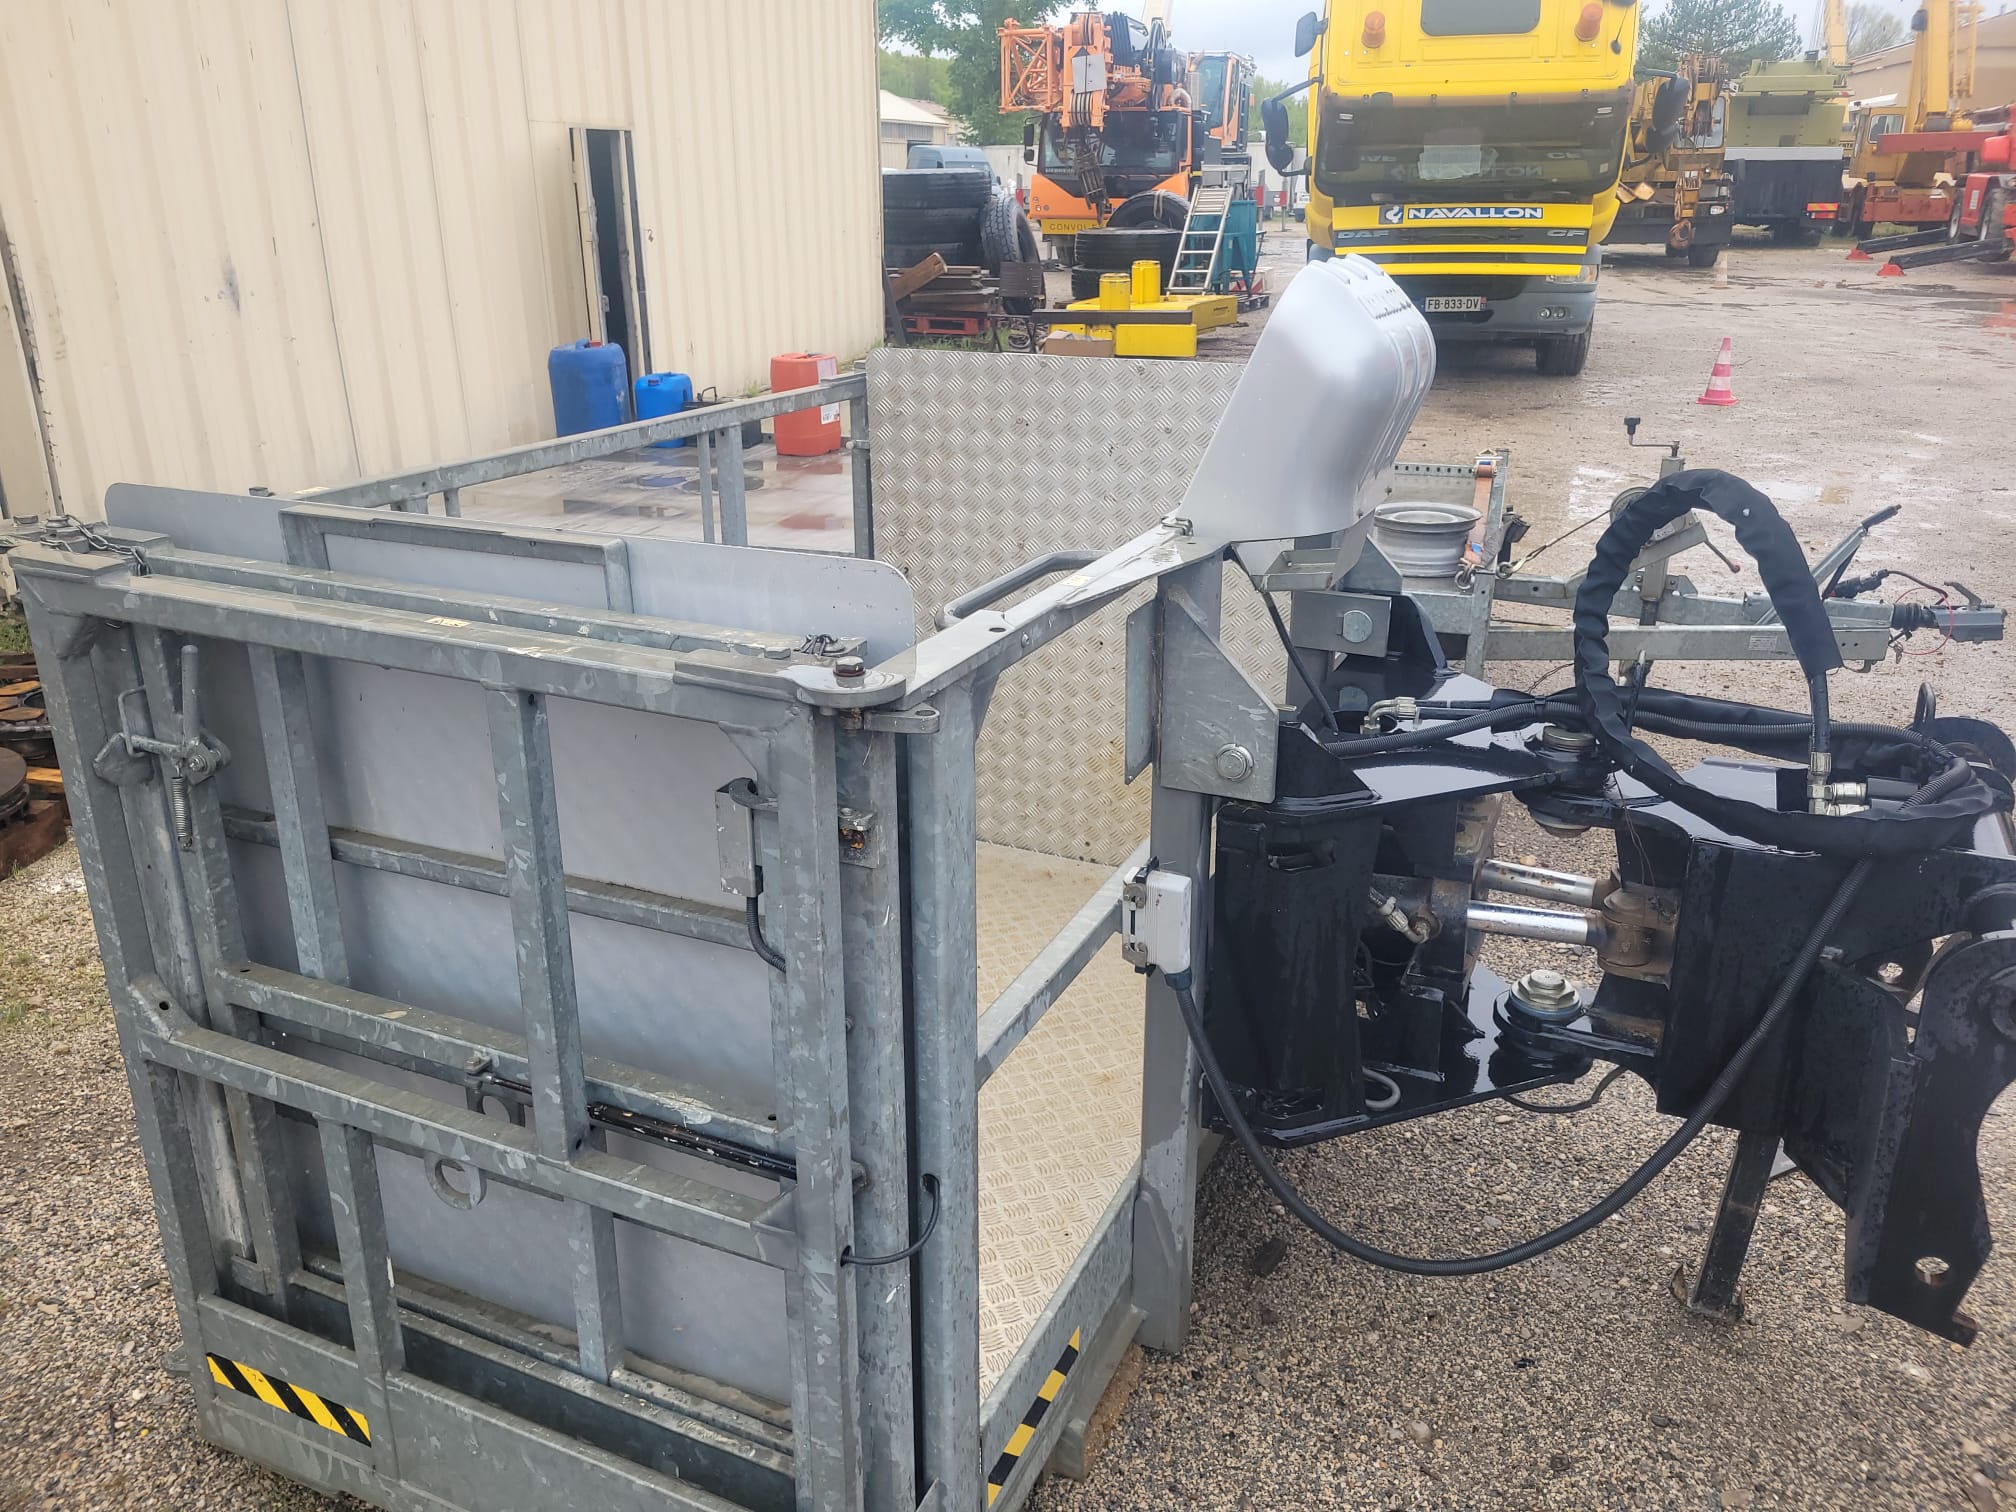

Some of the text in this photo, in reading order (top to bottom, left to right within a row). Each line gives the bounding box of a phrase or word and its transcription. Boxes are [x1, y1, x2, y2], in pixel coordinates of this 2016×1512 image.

[1408, 207, 1542, 219] NAVALLON
[1337, 230, 1390, 239] DAF
[1546, 229, 1586, 238] CF
[1427, 298, 1479, 310] FB-833-DV
